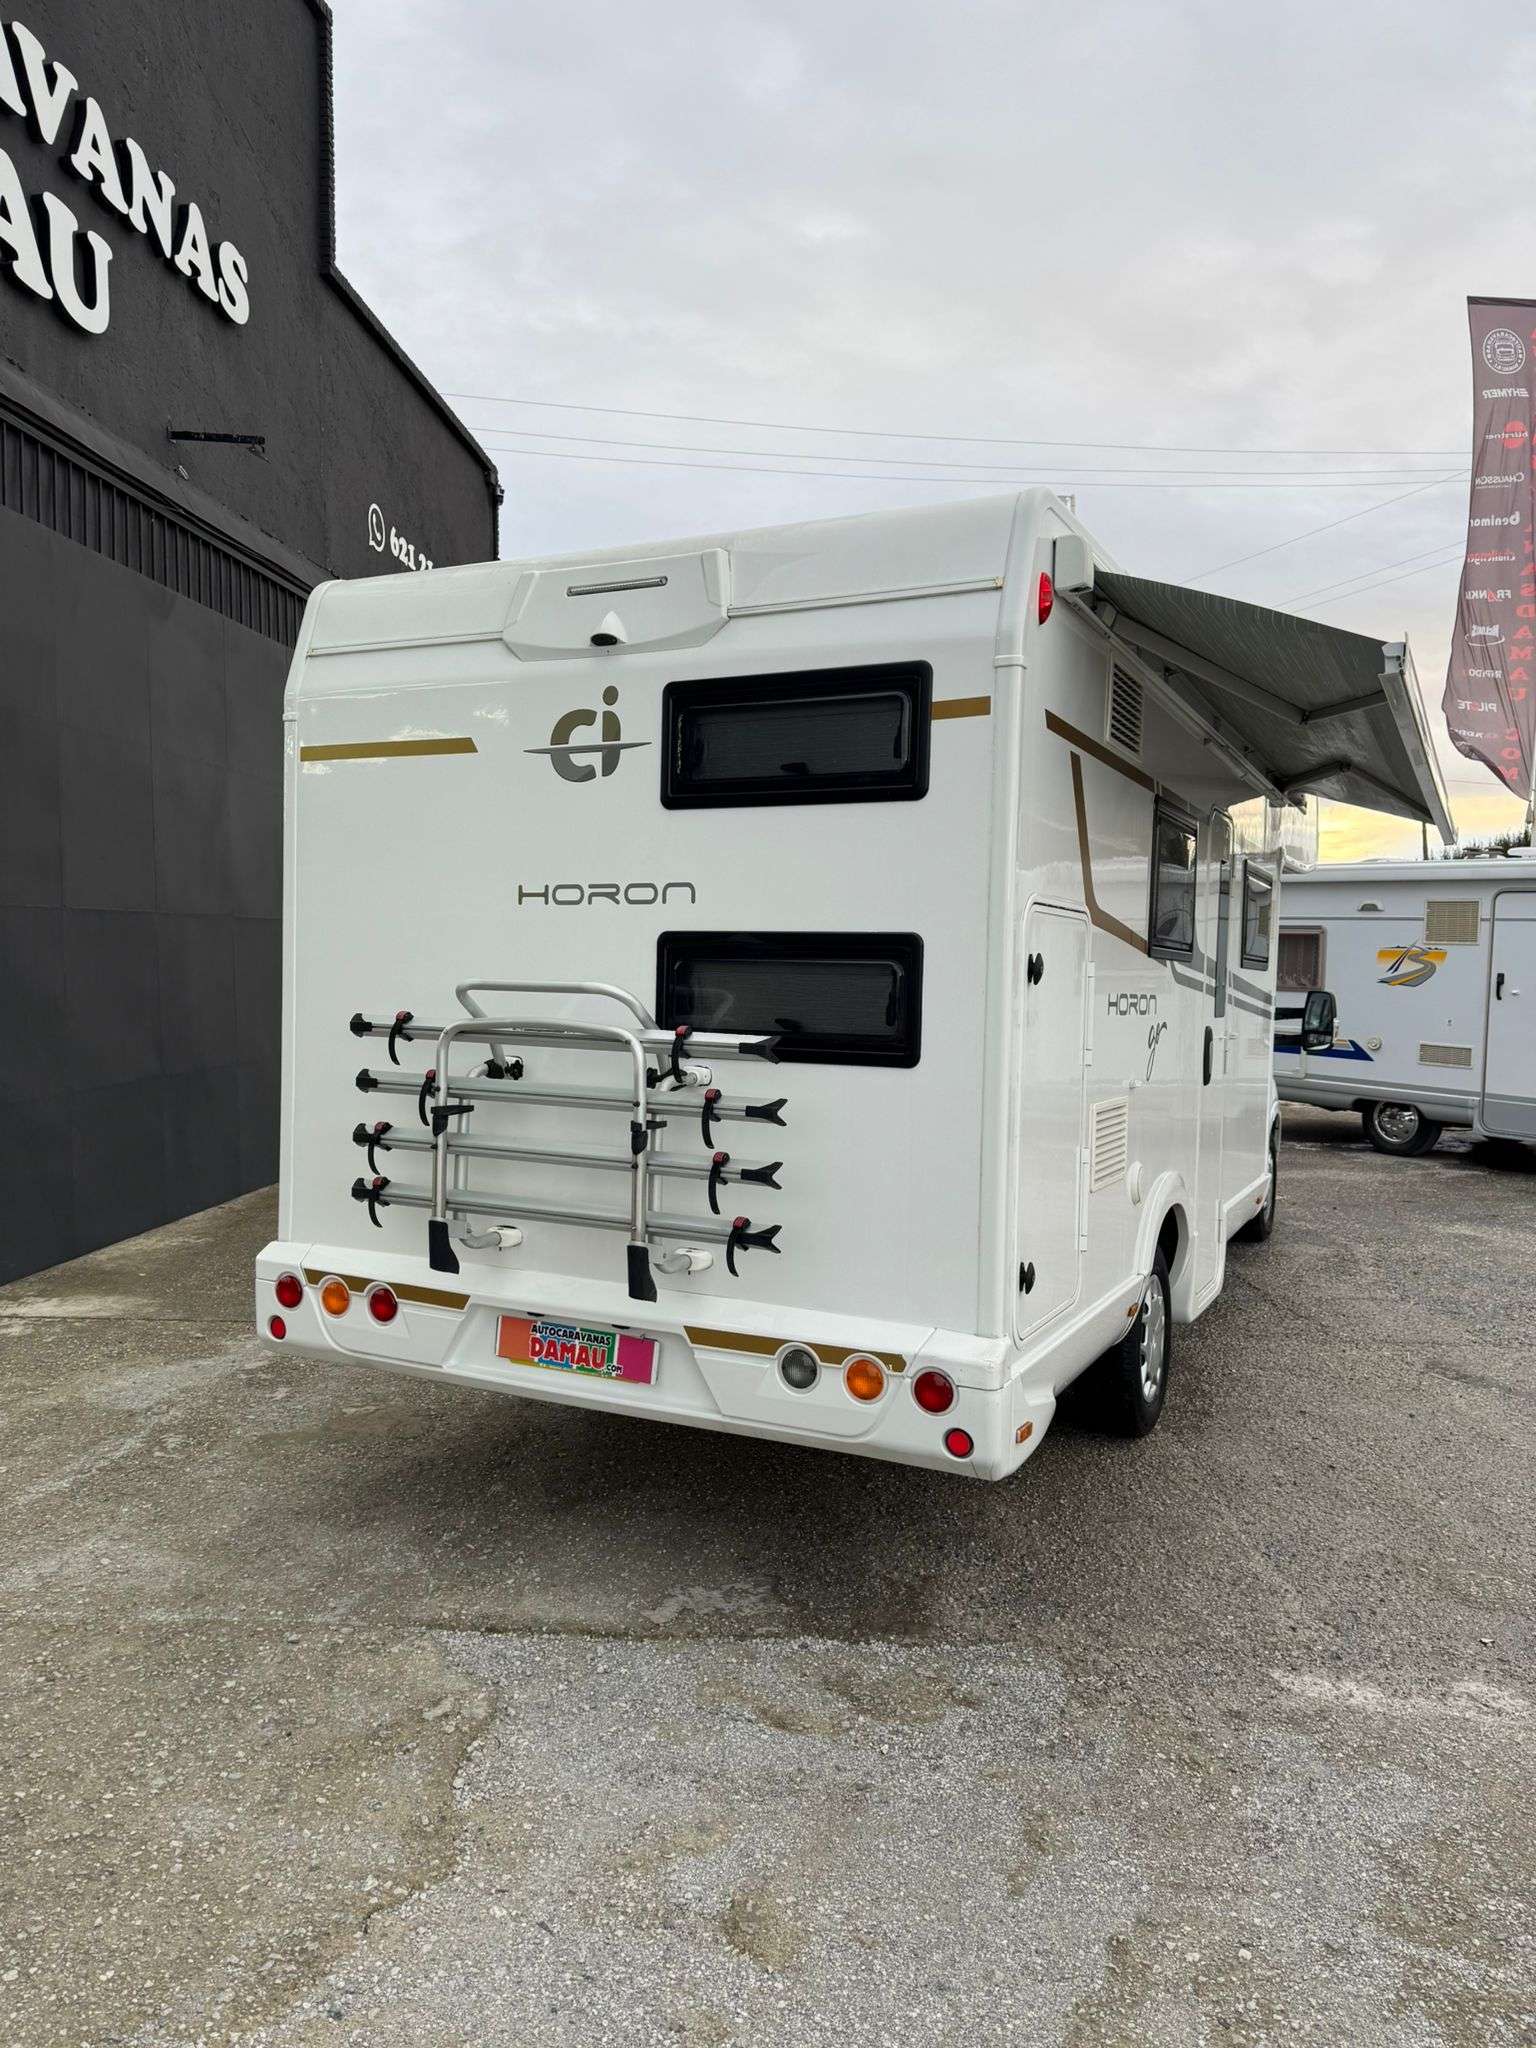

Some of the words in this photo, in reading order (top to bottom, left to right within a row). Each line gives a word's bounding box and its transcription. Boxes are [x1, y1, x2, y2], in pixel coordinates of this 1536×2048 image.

[390, 526, 416, 571] 621
[530, 1323, 611, 1346] AUTOCARAVANAS
[529, 1337, 608, 1369] DAMAU
